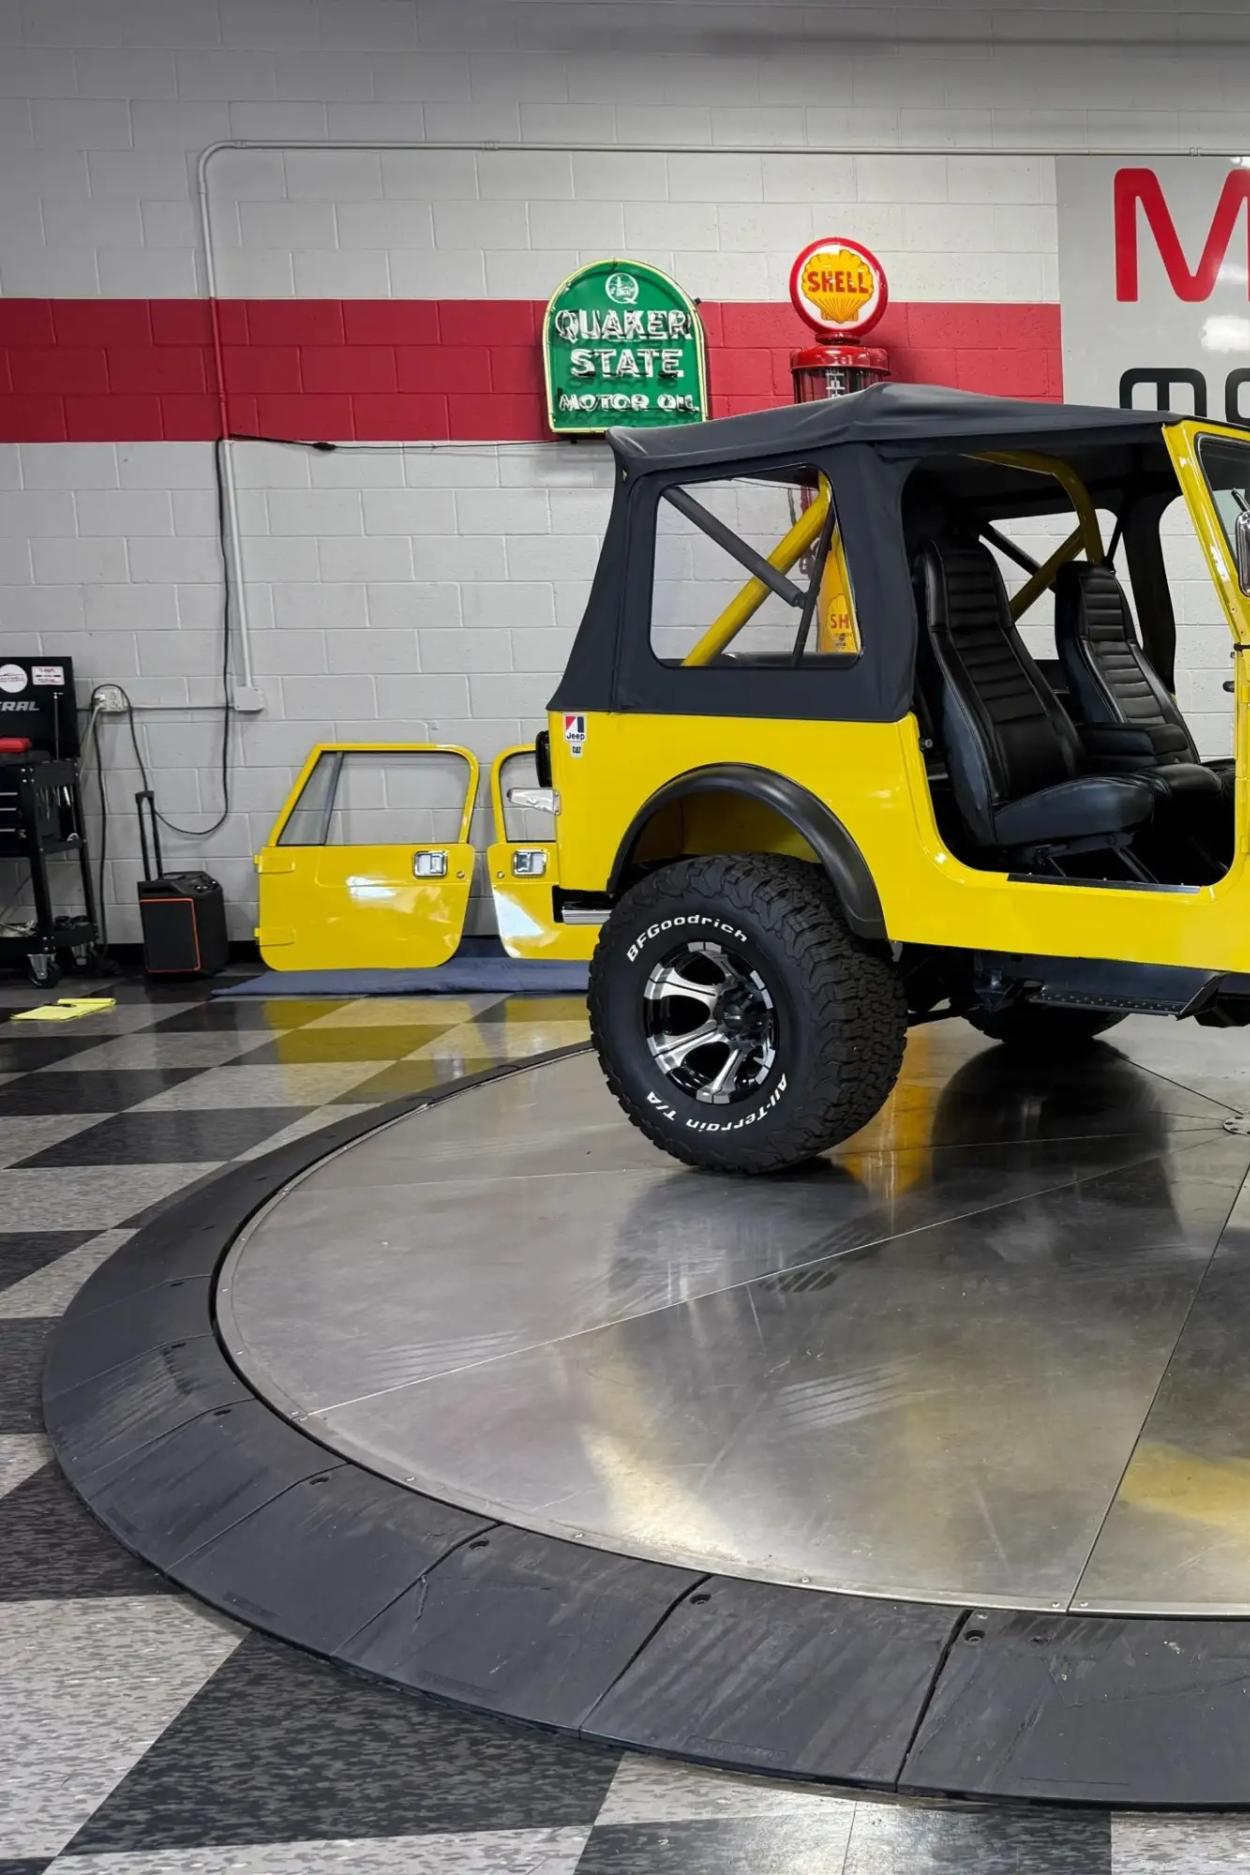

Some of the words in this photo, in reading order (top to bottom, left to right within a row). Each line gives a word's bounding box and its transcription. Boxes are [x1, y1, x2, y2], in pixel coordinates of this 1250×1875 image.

[807, 271, 869, 294] SHELL
[555, 309, 693, 344] QUAKER
[570, 348, 684, 378] STATE
[559, 393, 649, 412] MOTOR
[657, 394, 700, 412] OIL
[0, 701, 40, 711] RAL
[566, 732, 585, 741] Jeep
[626, 914, 748, 962] BFGoodrich
[646, 1091, 675, 1121] T/A
[685, 1072, 787, 1132] All-Terrain
